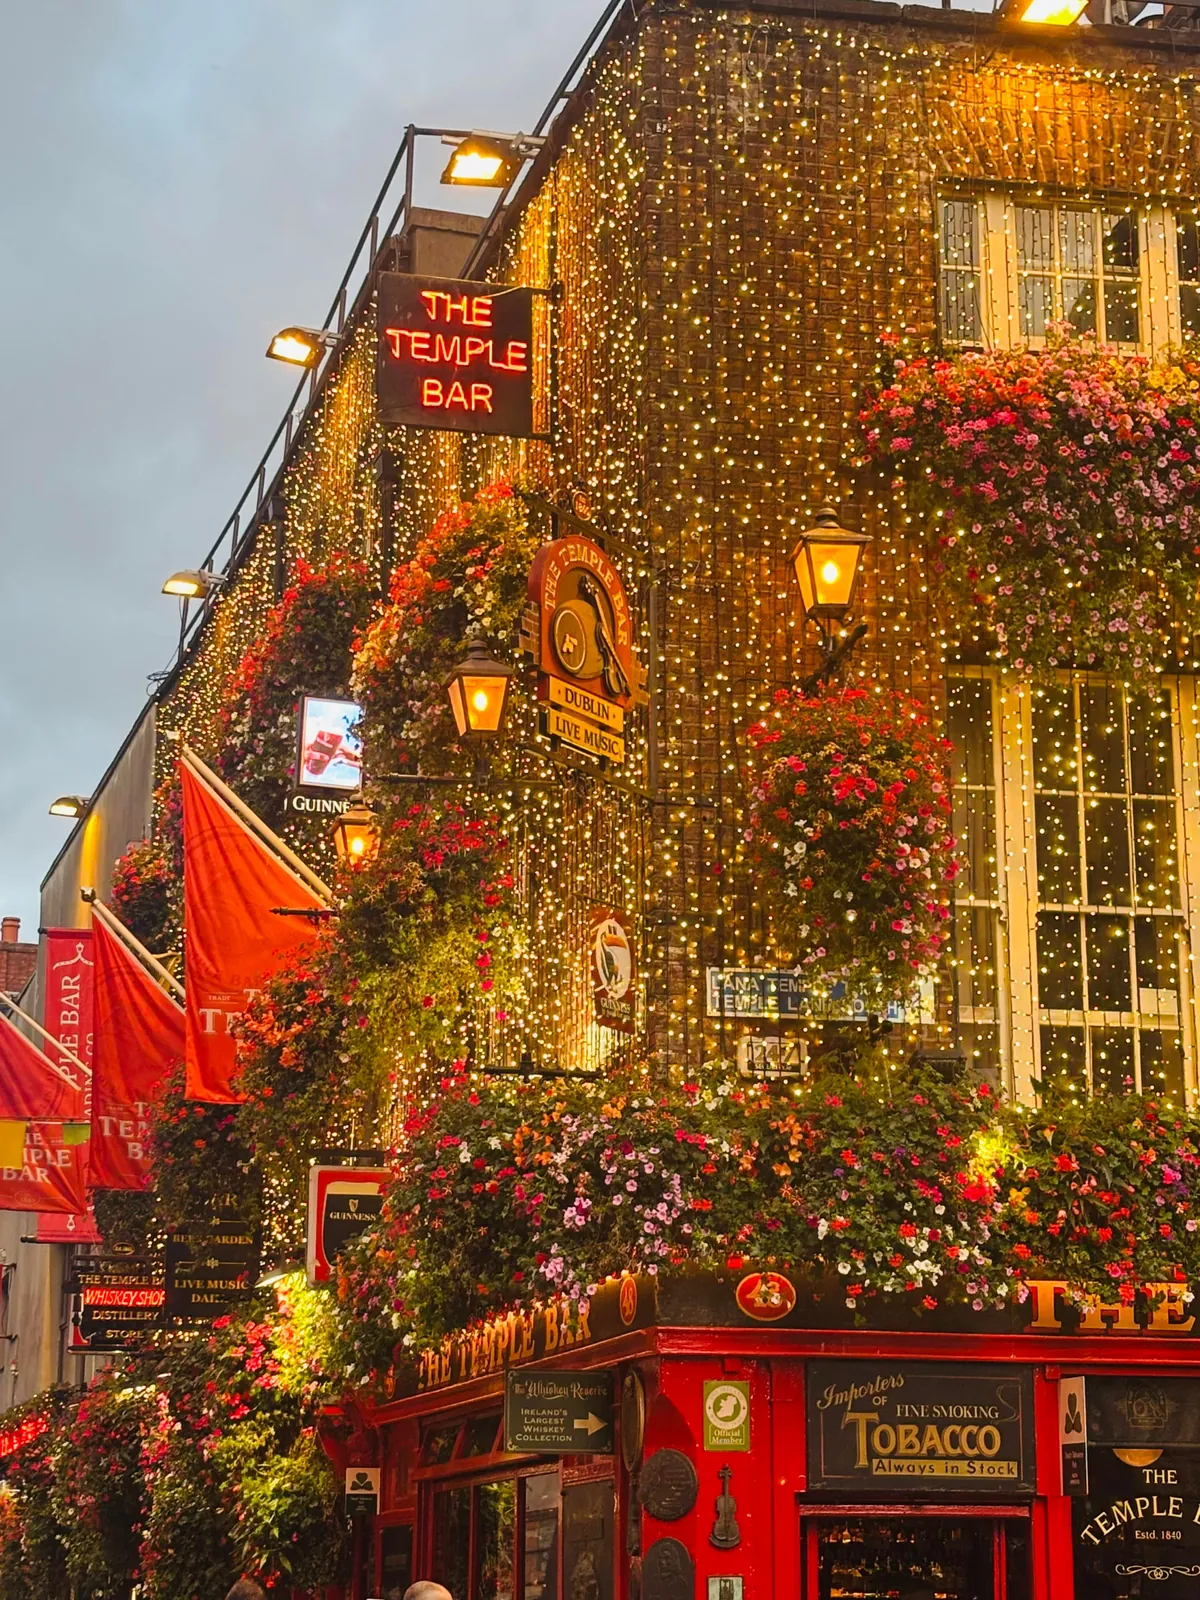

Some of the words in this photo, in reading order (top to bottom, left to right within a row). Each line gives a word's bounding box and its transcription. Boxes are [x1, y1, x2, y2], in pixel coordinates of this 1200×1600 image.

[421, 291, 493, 327] THE
[385, 328, 527, 372] TEMPLE
[423, 379, 493, 413] BAR
[544, 560, 561, 611] THE
[558, 543, 614, 589] TEMPLE
[612, 591, 628, 646] BAR
[564, 687, 610, 721] DUBLIN
[555, 716, 581, 741] LIVE
[584, 729, 619, 756] MUSIC
[292, 796, 352, 814] GUINNE
[60, 973, 81, 1026] BAR
[2, 1164, 52, 1184] BAR
[329, 1211, 377, 1221] GUINNESS
[78, 1275, 101, 1284] THE
[103, 1275, 149, 1285] TEMPLE
[174, 1279, 204, 1289] LIVE
[206, 1280, 249, 1290] MUSIC
[85, 1289, 138, 1306] WHISKEY
[92, 1310, 159, 1320] DISTILLERY
[1026, 1280, 1198, 1333] THE
[105, 1329, 145, 1338] STORE
[544, 1300, 592, 1352] BAR
[525, 1380, 569, 1399] Whiskey
[570, 1382, 608, 1400] Reserve
[816, 1373, 905, 1411] Importers
[872, 1396, 887, 1406] OF
[521, 1408, 568, 1416] IRELAND'S
[896, 1404, 930, 1418] FINE
[932, 1405, 999, 1419] SMOKING
[523, 1425, 565, 1433] WHISKEY
[713, 1429, 740, 1437] Official
[711, 1436, 742, 1444] Member
[841, 1412, 1002, 1469] TOBACCO
[874, 1459, 935, 1475] Always
[944, 1462, 959, 1474] in
[966, 1460, 1015, 1475] Stock
[1142, 1469, 1178, 1484] THE
[1080, 1495, 1184, 1545] TEMPLE
[1135, 1530, 1158, 1540] Estd.
[1161, 1530, 1182, 1540] 1840
